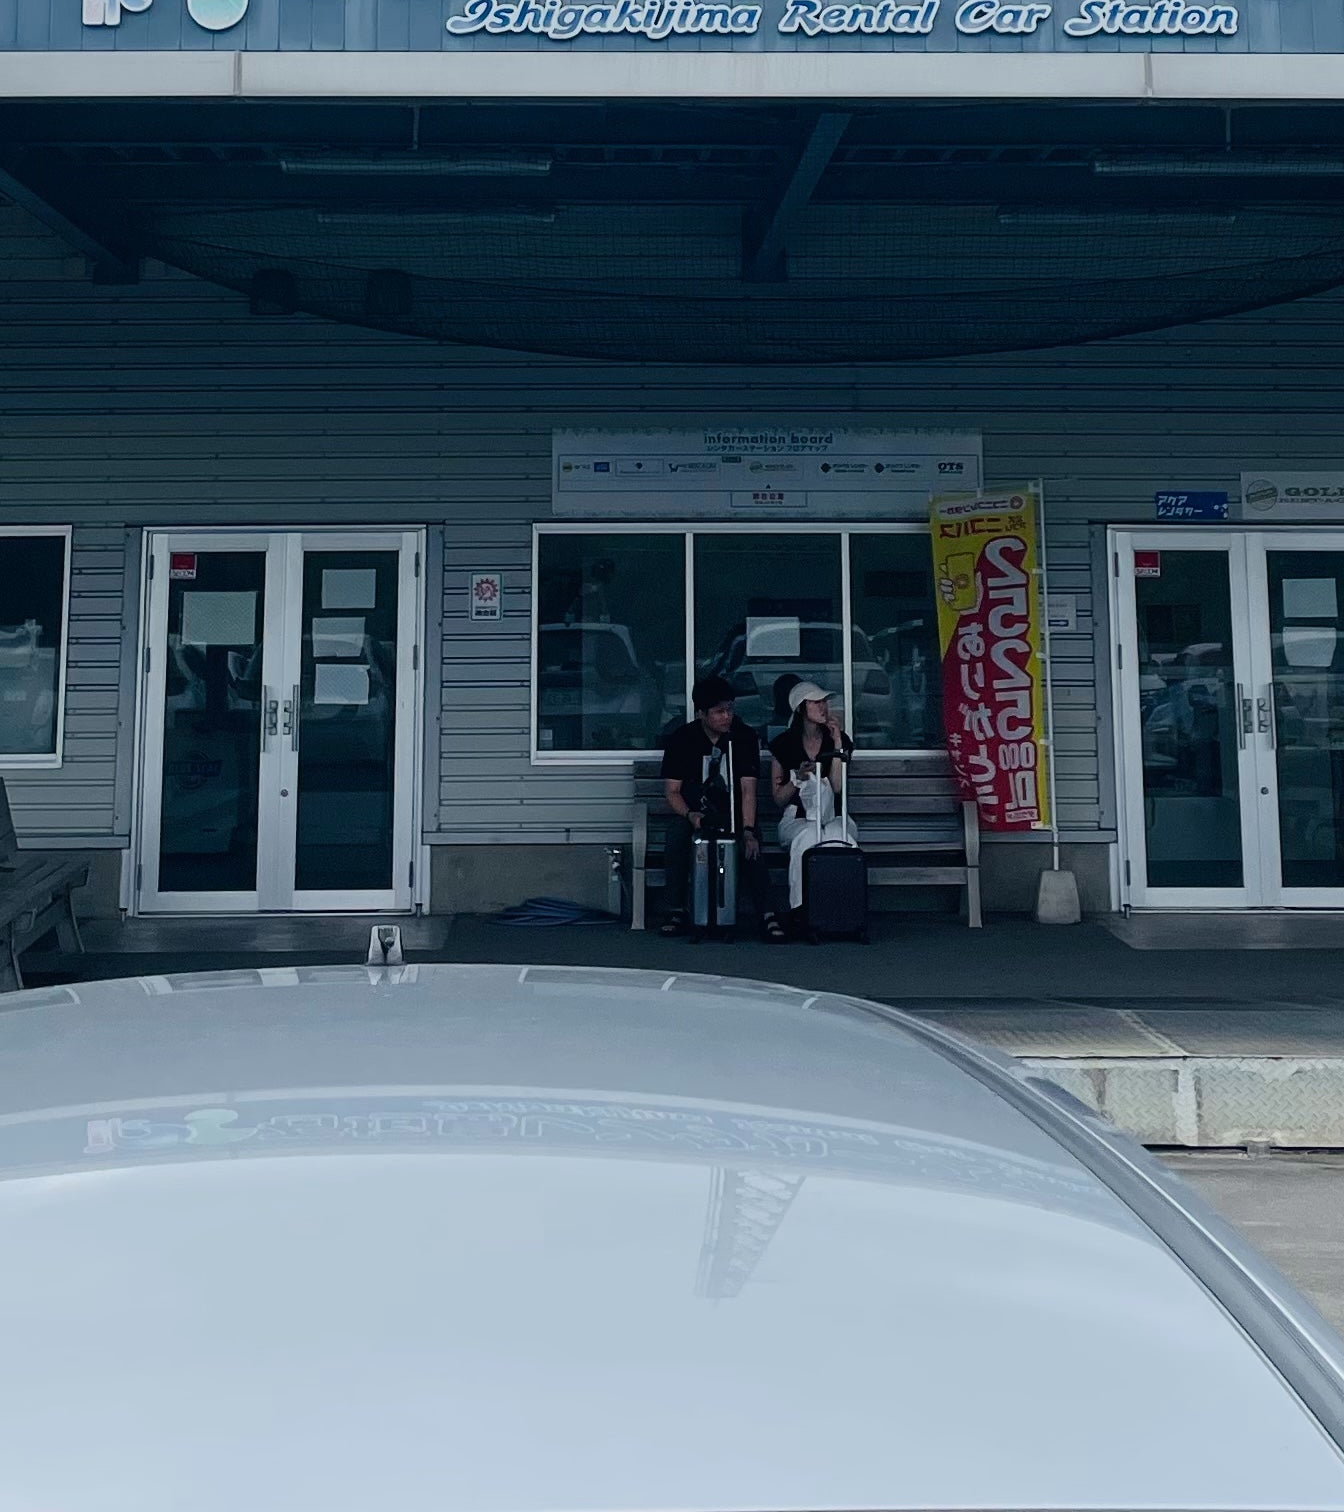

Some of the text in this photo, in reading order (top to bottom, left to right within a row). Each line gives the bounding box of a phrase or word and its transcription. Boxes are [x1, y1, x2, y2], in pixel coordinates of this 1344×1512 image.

[704, 432, 834, 445] information board
[1157, 495, 1188, 506] アクア
[1158, 506, 1203, 517] レンタカー
